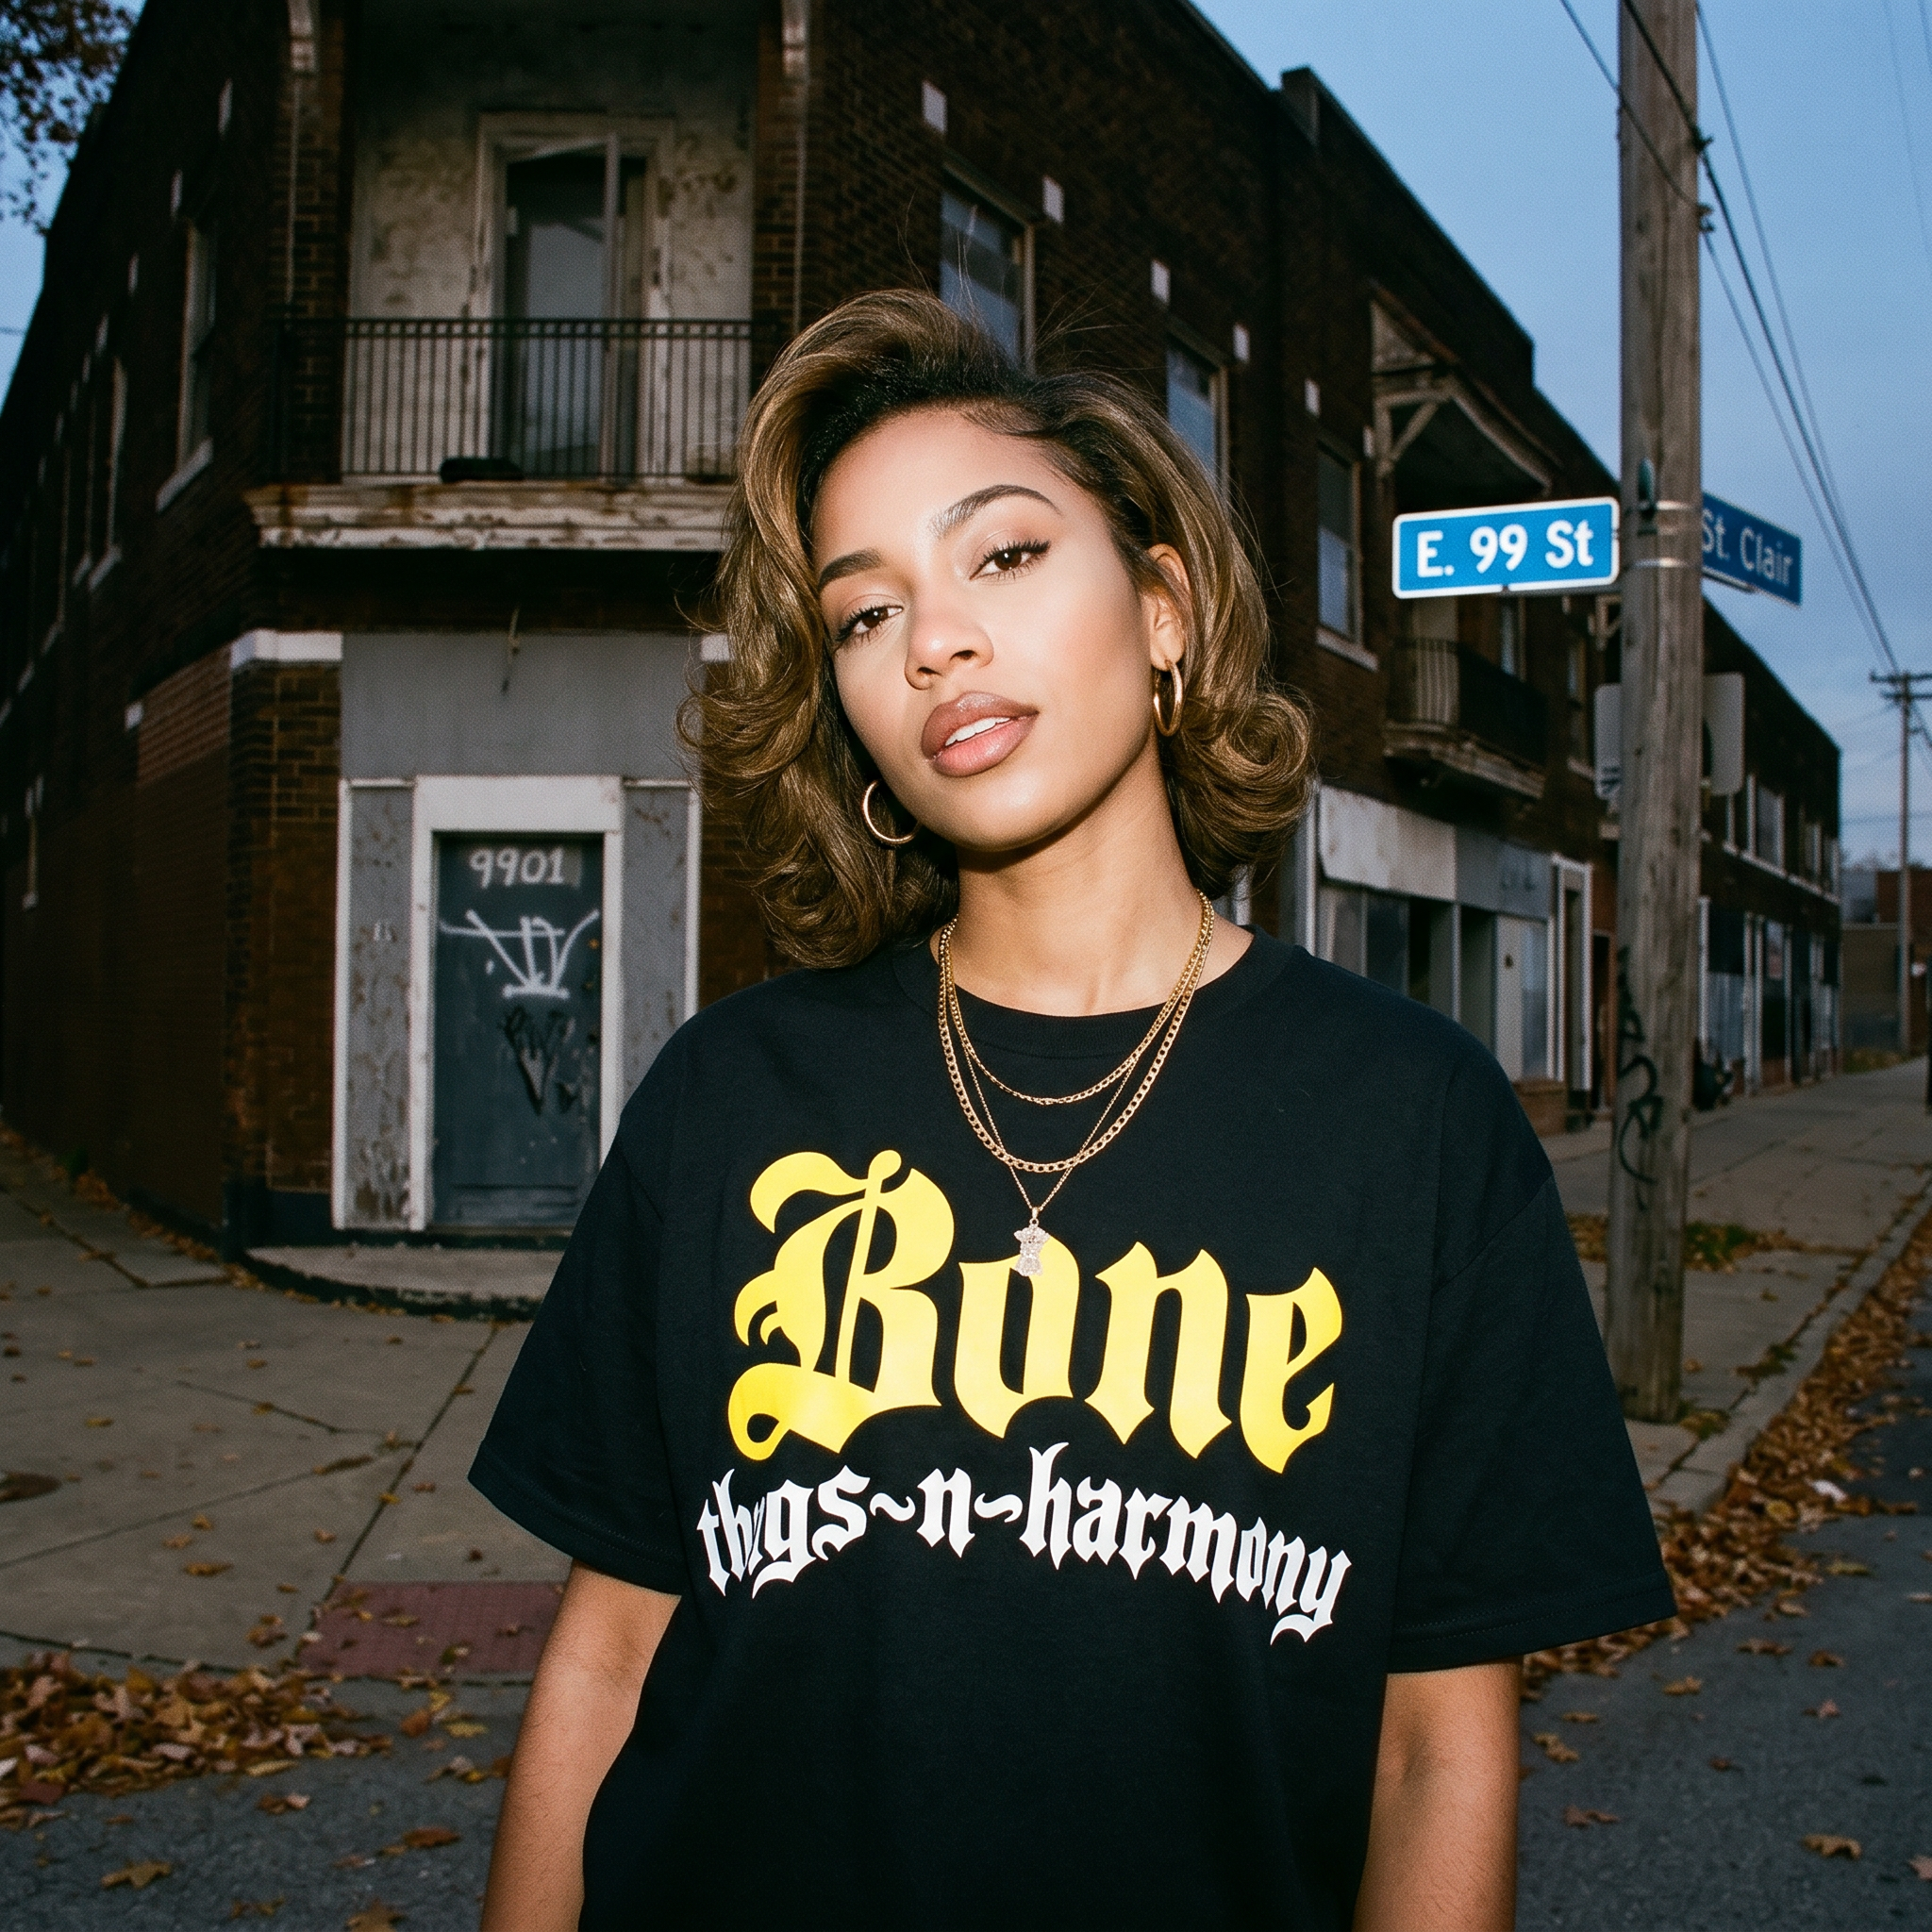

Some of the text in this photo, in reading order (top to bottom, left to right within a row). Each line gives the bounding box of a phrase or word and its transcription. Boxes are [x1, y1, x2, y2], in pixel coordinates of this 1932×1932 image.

[1417, 520, 1594, 577] E. 99 St
[1740, 526, 1792, 585] Clair
[469, 847, 566, 888] 9901
[727, 1149, 1342, 1474] Bone
